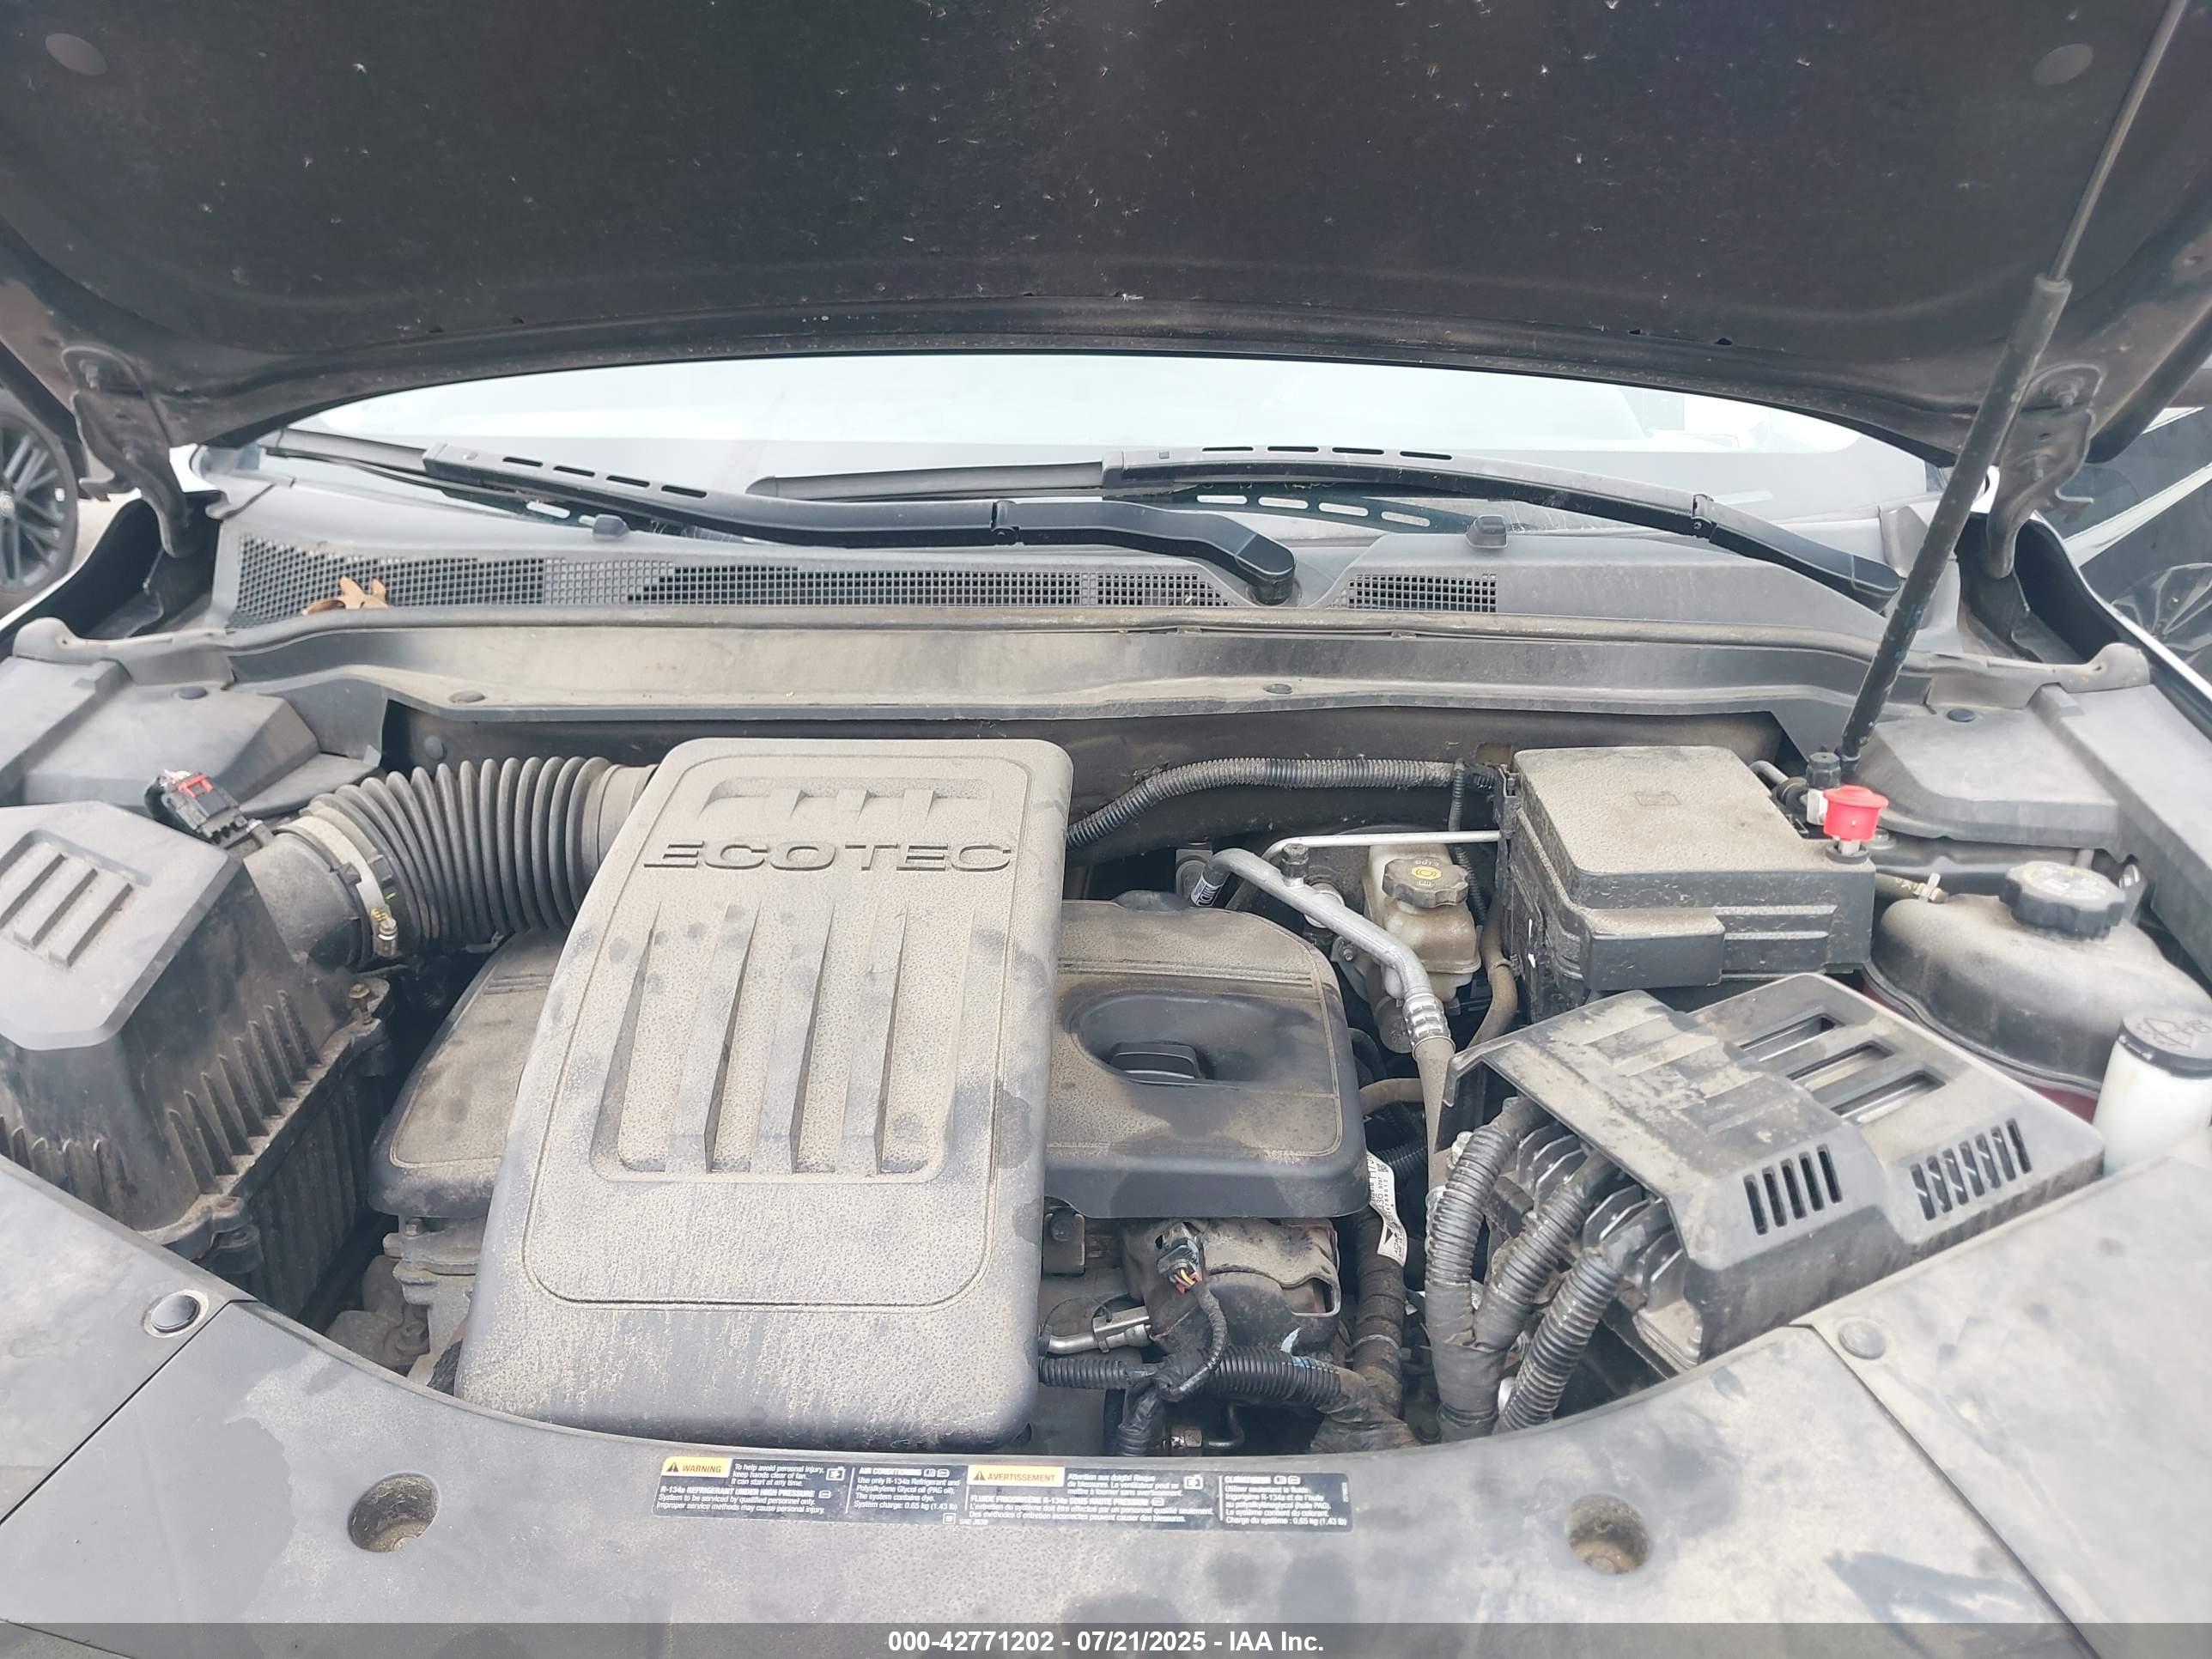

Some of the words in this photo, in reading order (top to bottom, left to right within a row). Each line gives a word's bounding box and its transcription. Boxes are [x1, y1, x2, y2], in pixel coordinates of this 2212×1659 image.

[642, 838, 1014, 873] ECOTEC
[684, 1464, 722, 1474] WARNING
[744, 1464, 757, 1473] help
[777, 1465, 804, 1474] personal
[732, 1471, 749, 1480] keep
[988, 1473, 1055, 1481] AVERTISSEMENT
[774, 1479, 787, 1487] any
[896, 1486, 916, 1495] Glycol
[658, 1494, 683, 1503] System
